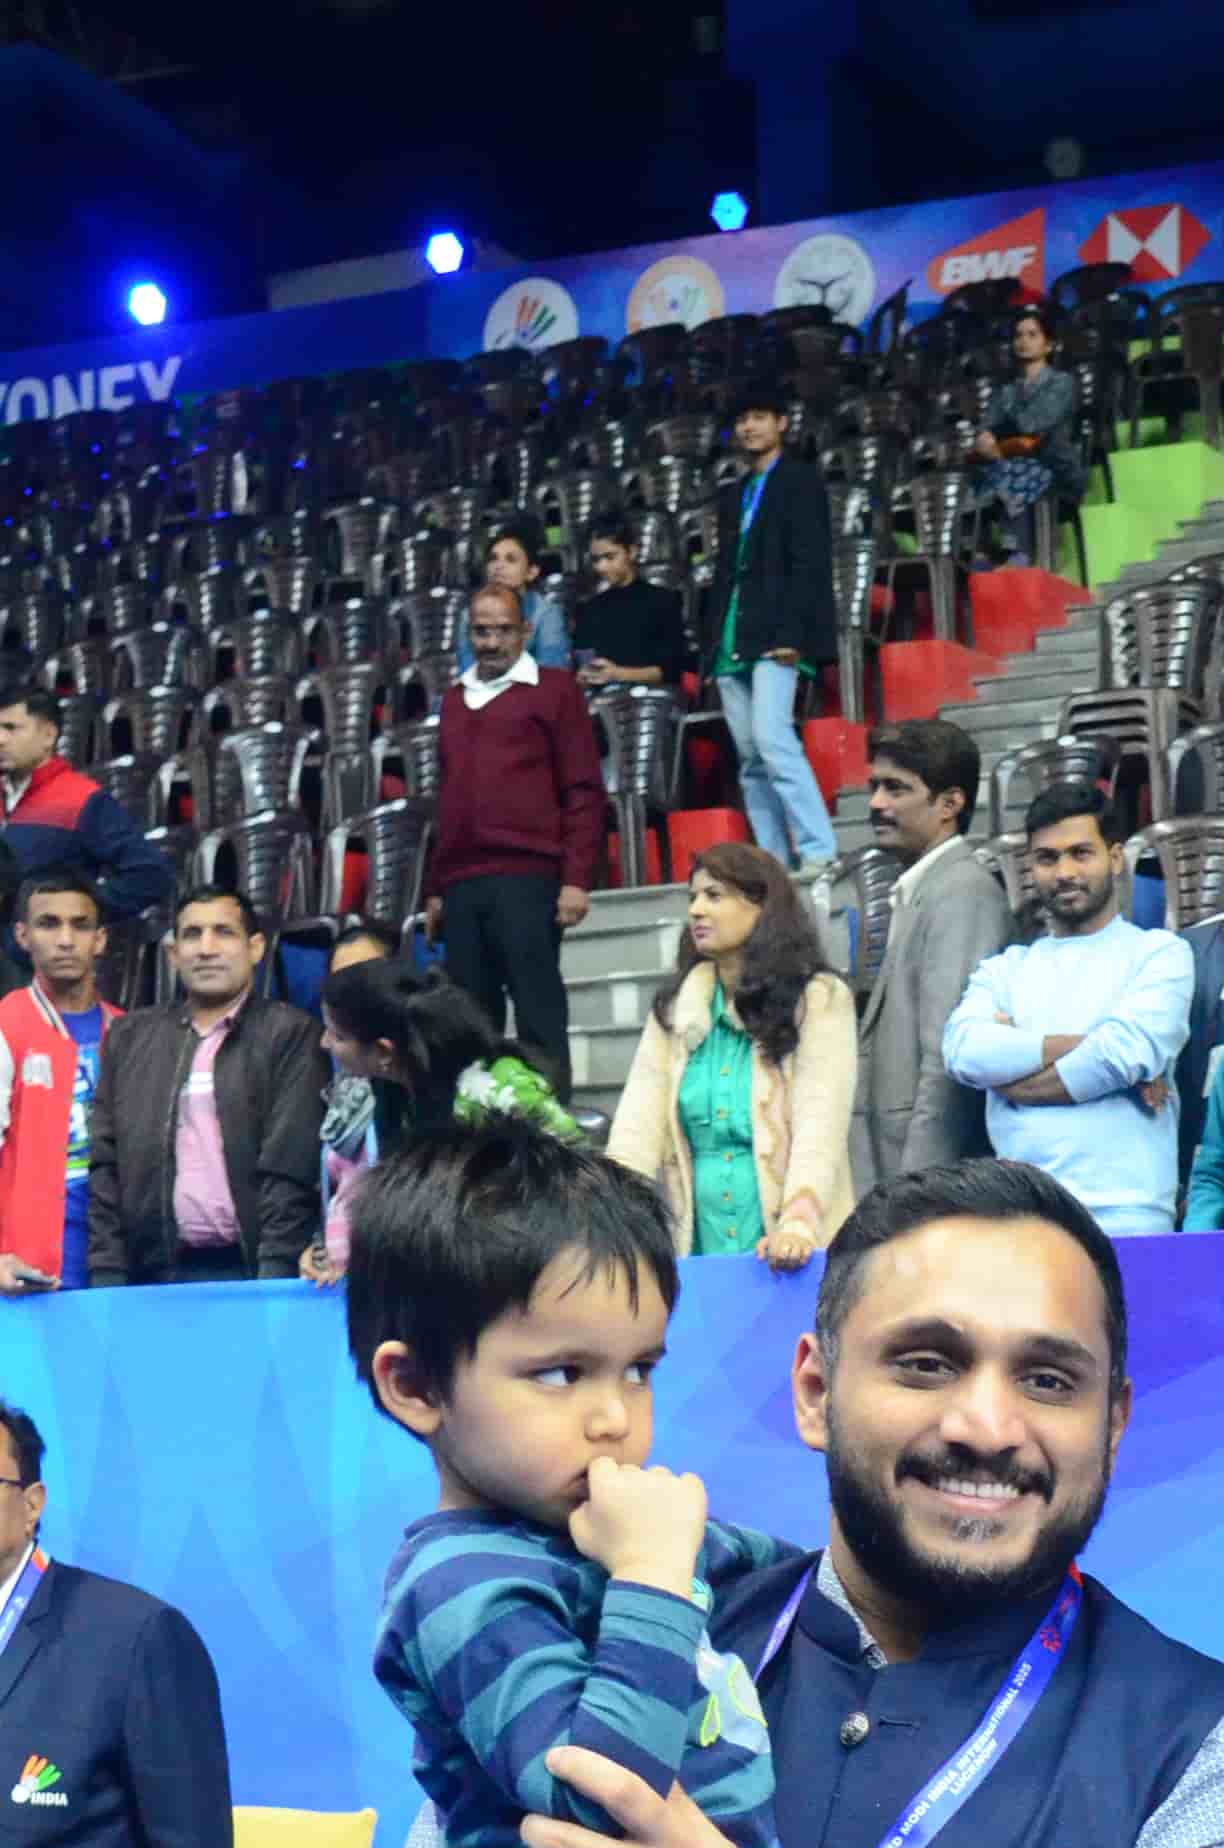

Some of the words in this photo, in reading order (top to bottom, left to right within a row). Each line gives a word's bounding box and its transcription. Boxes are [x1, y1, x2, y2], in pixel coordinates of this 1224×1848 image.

[938, 245, 1038, 288] BWF
[0, 356, 182, 425] ONEX
[31, 1791, 69, 1807] INDIA
[900, 1800, 931, 1836] MODI
